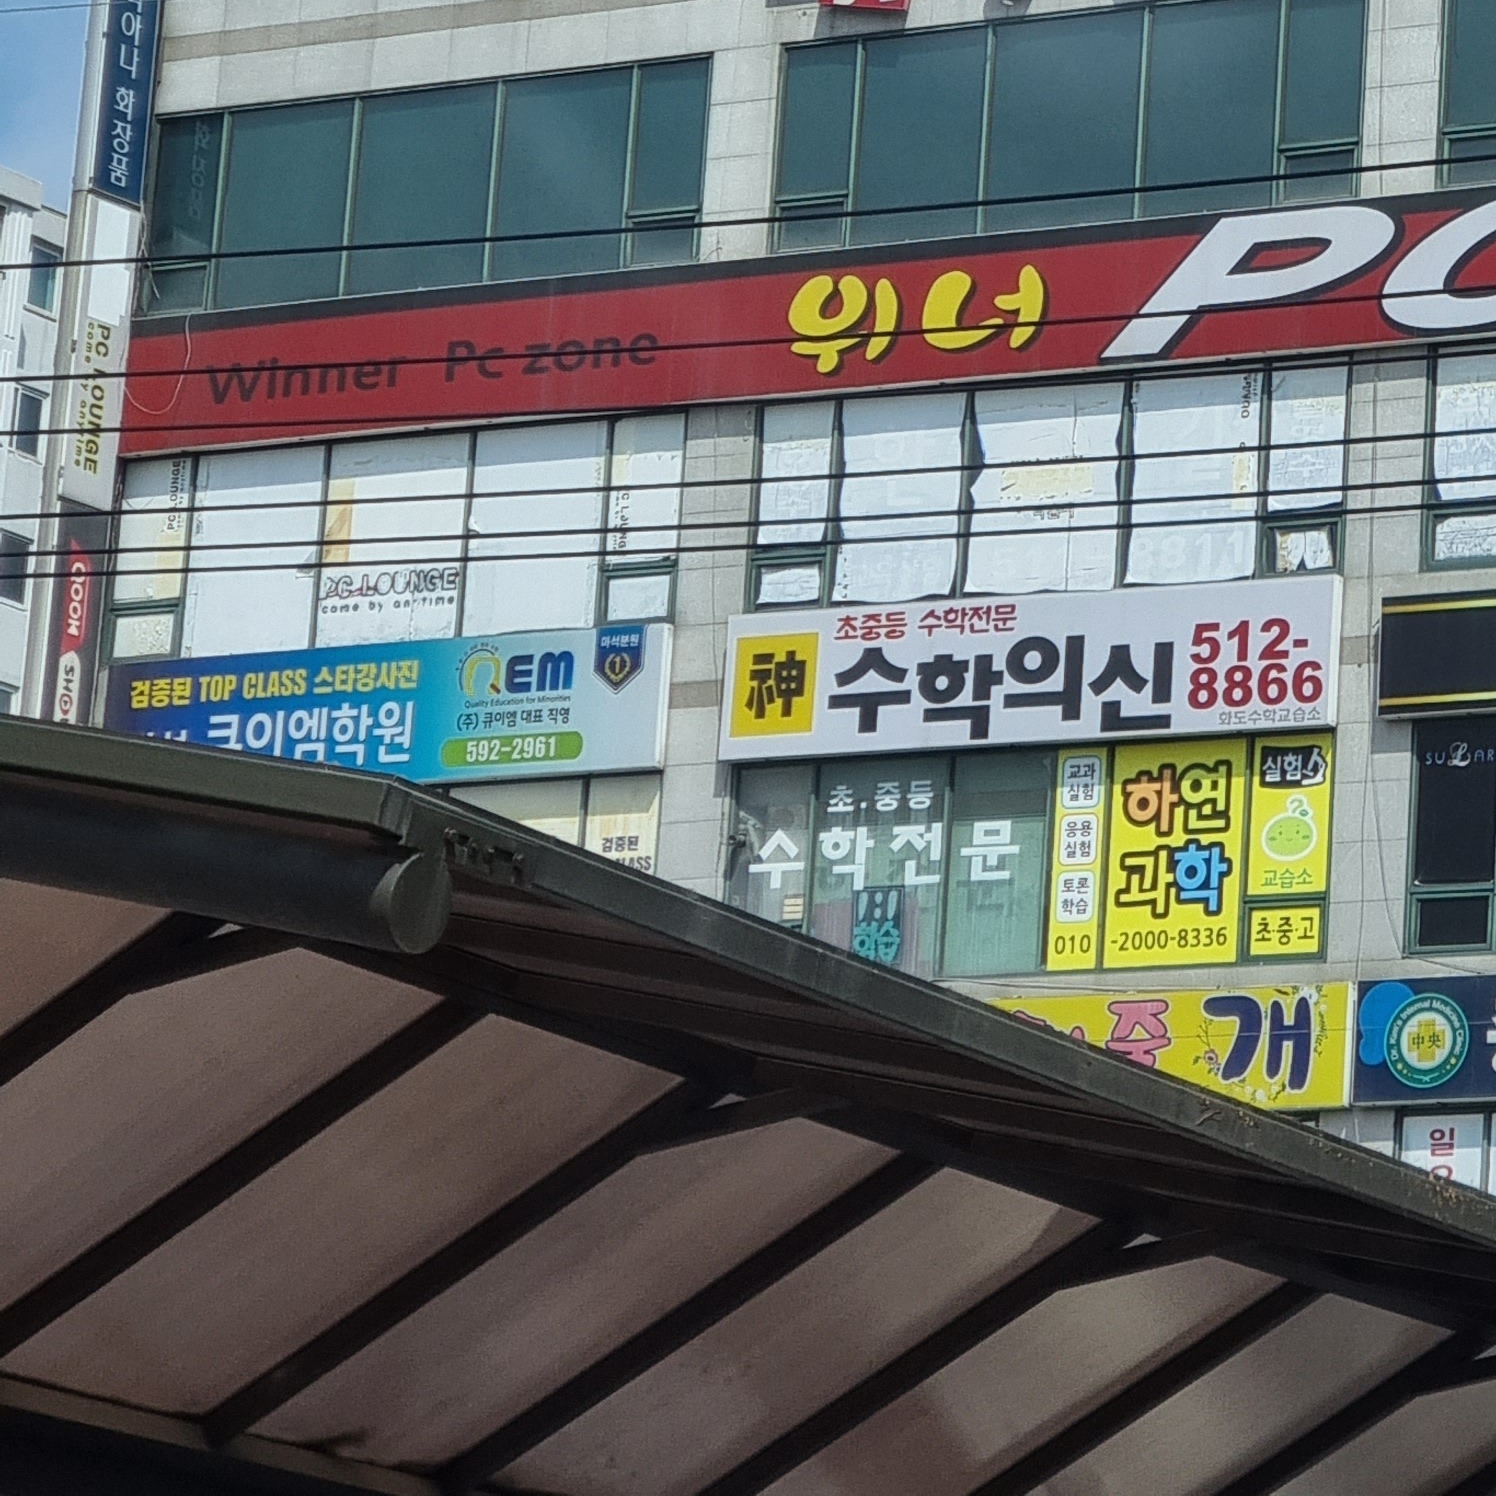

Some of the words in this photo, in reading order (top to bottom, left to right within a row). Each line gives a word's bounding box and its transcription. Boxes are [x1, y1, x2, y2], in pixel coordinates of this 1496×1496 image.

[109, 86, 136, 188] 화장품
[788, 264, 1045, 374] 위너
[95, 323, 111, 358] PC
[206, 356, 403, 405] Winner
[522, 331, 659, 375] zone
[73, 400, 89, 468] anyime
[361, 567, 460, 597] LOUNGE
[321, 602, 360, 614] come
[368, 600, 384, 613] by
[834, 611, 907, 641] 초중등
[917, 604, 1017, 637] 수학전문
[1190, 618, 1309, 665] 512-
[131, 677, 192, 709] 검증된
[199, 675, 236, 702] TOP
[243, 669, 307, 699] CLASS
[313, 660, 419, 694] 스타강사진
[745, 650, 806, 719] 神
[827, 634, 1174, 740] 수학의신
[1187, 660, 1323, 709] 8866
[464, 699, 489, 710] Quality
[490, 697, 524, 708] Education
[537, 693, 571, 704] Minorities
[1218, 706, 1321, 726] 화도수학교습소
[457, 712, 479, 732] (주)
[482, 710, 517, 730] 큐이엠
[521, 708, 543, 724] 대표
[547, 706, 571, 725] 직영
[466, 735, 557, 763] 592-2961
[1067, 759, 1097, 780] 교과
[1067, 783, 1094, 802] 실험
[1124, 762, 1229, 835] 하연
[1065, 820, 1093, 839] 응용
[602, 836, 639, 853] 검증된
[748, 820, 1021, 892] 수학전문
[1065, 841, 1092, 859] 실험
[1062, 877, 1090, 895] 토론
[1117, 841, 1230, 917] 과학
[1261, 868, 1313, 889] 교습소
[1062, 897, 1089, 916] 학습
[1054, 934, 1091, 955] 010
[1411, 1032, 1441, 1051] 中央
